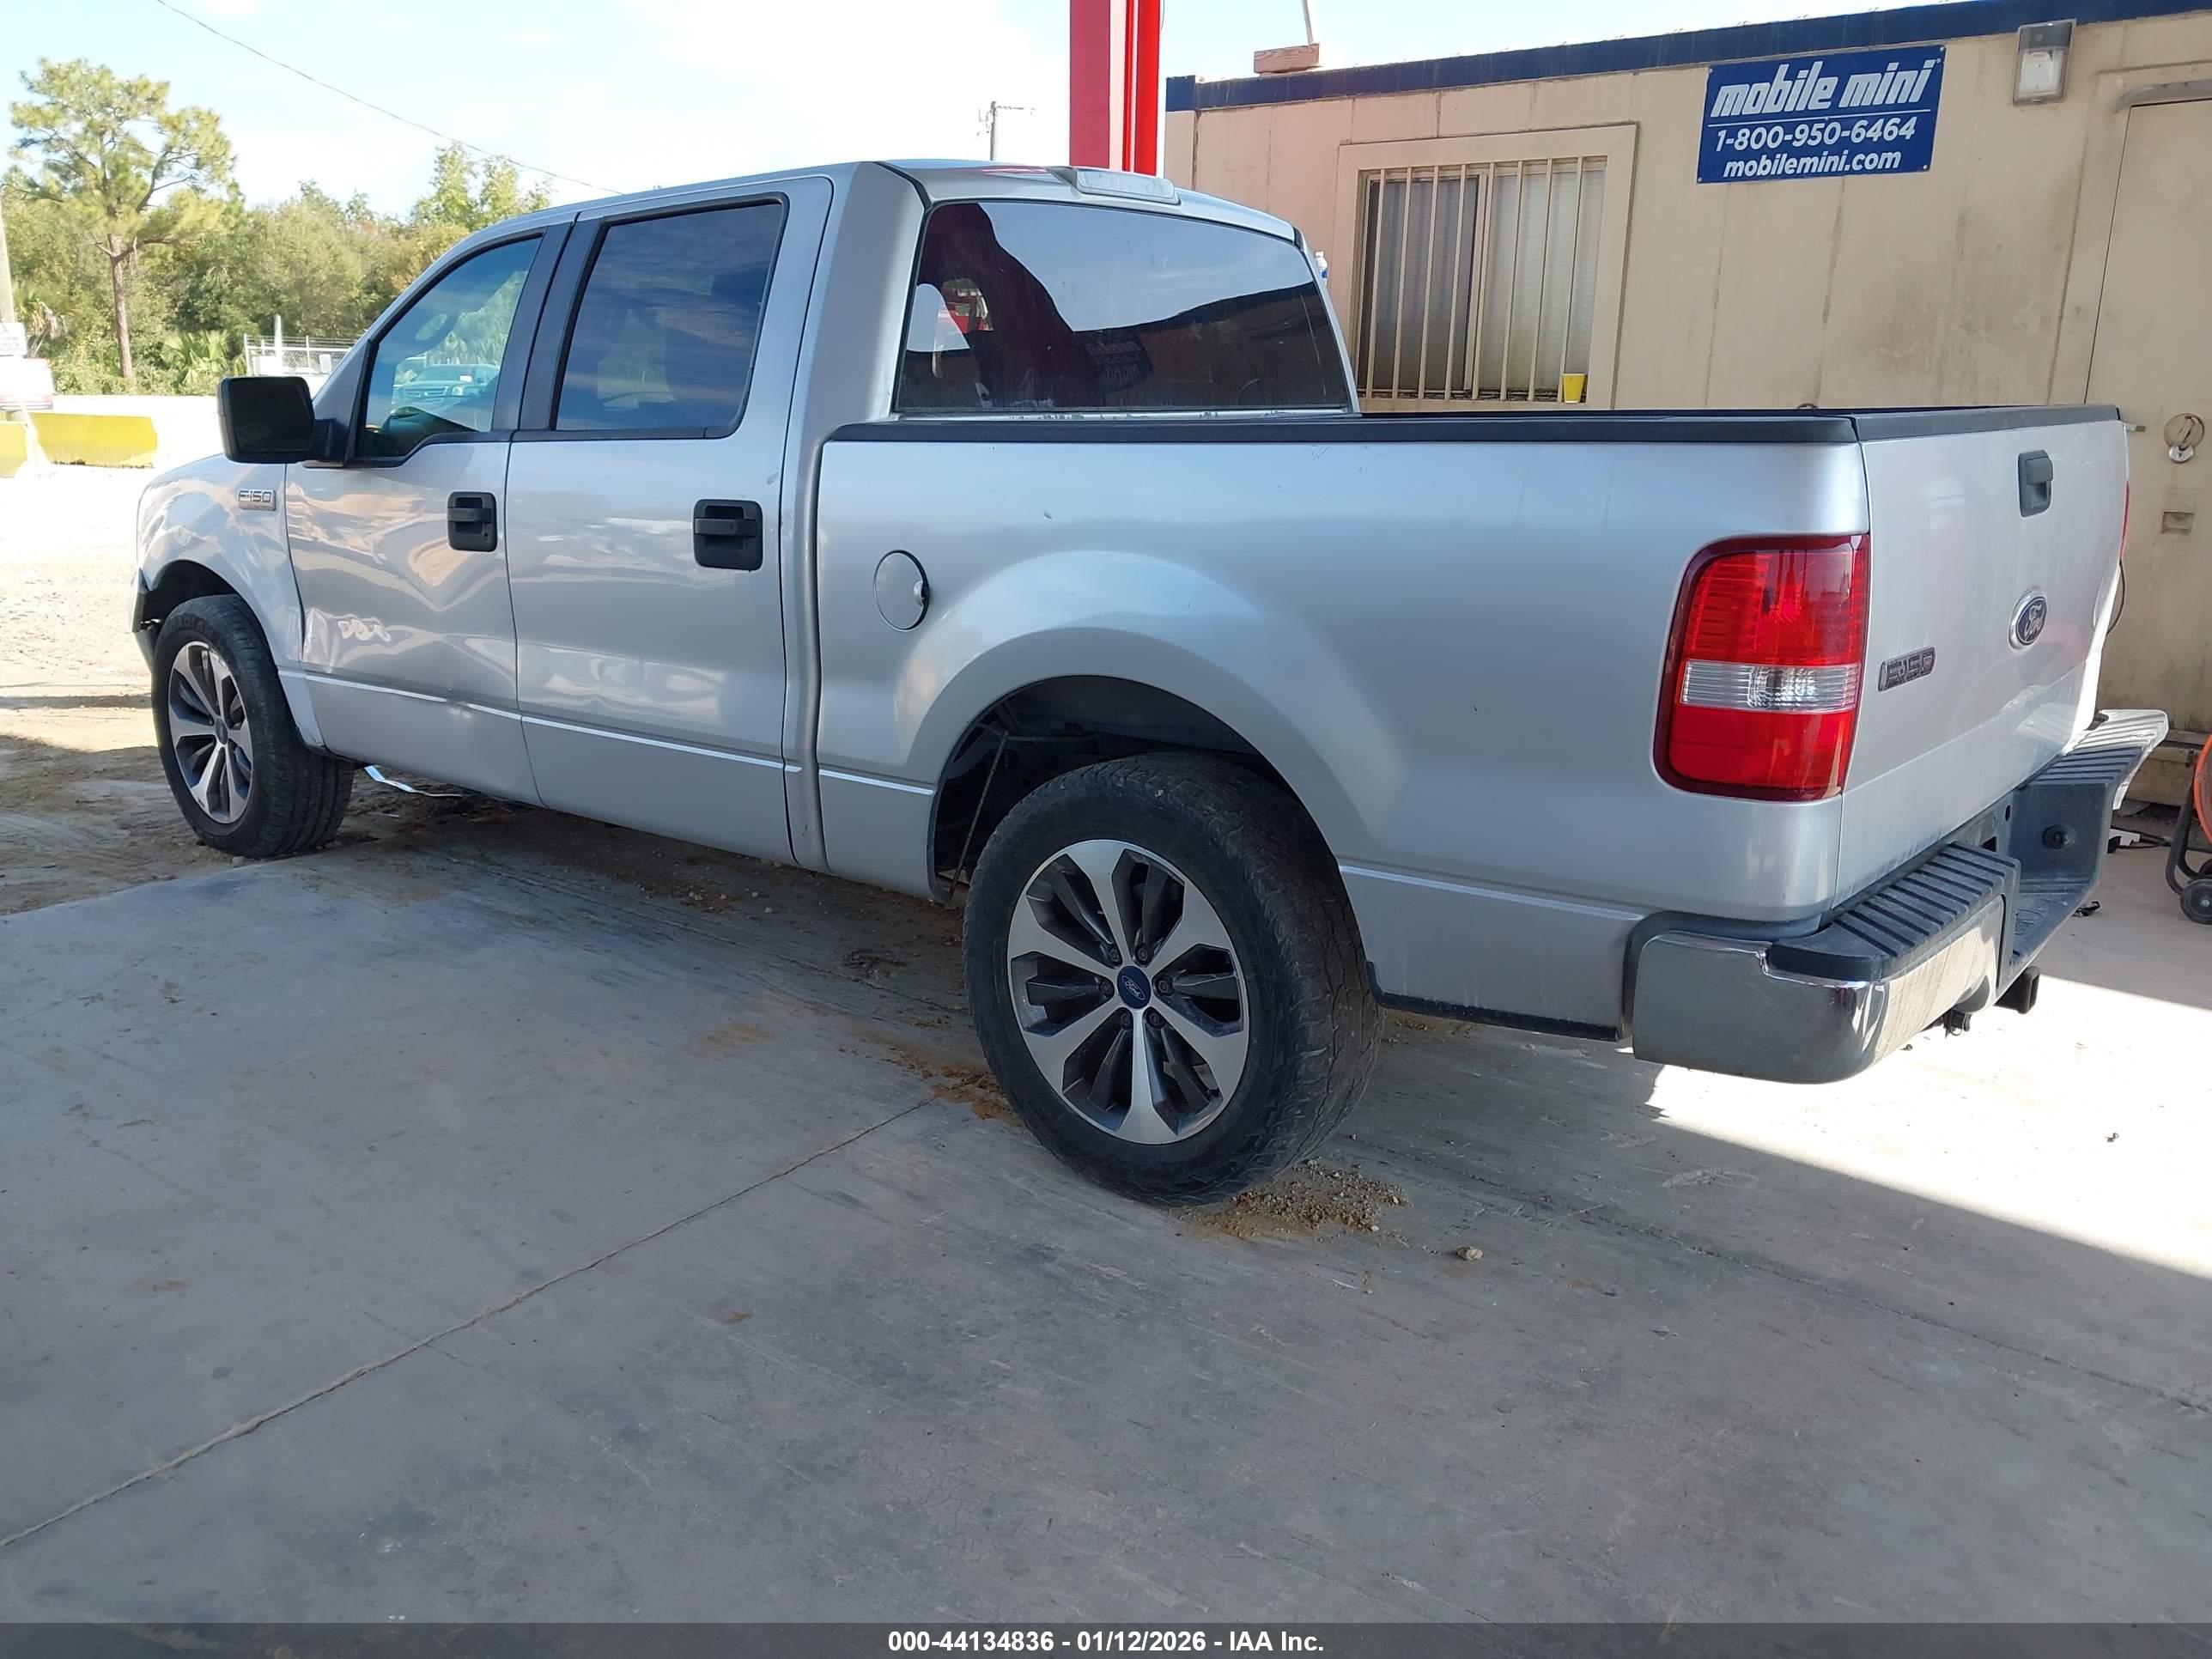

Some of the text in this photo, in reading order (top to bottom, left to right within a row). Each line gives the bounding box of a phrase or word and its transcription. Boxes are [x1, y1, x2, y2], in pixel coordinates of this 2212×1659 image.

[1711, 59, 1936, 117] mobile mini
[1716, 117, 1917, 152] 1-800-950-6464
[1723, 150, 1902, 178] mobilemini.com
